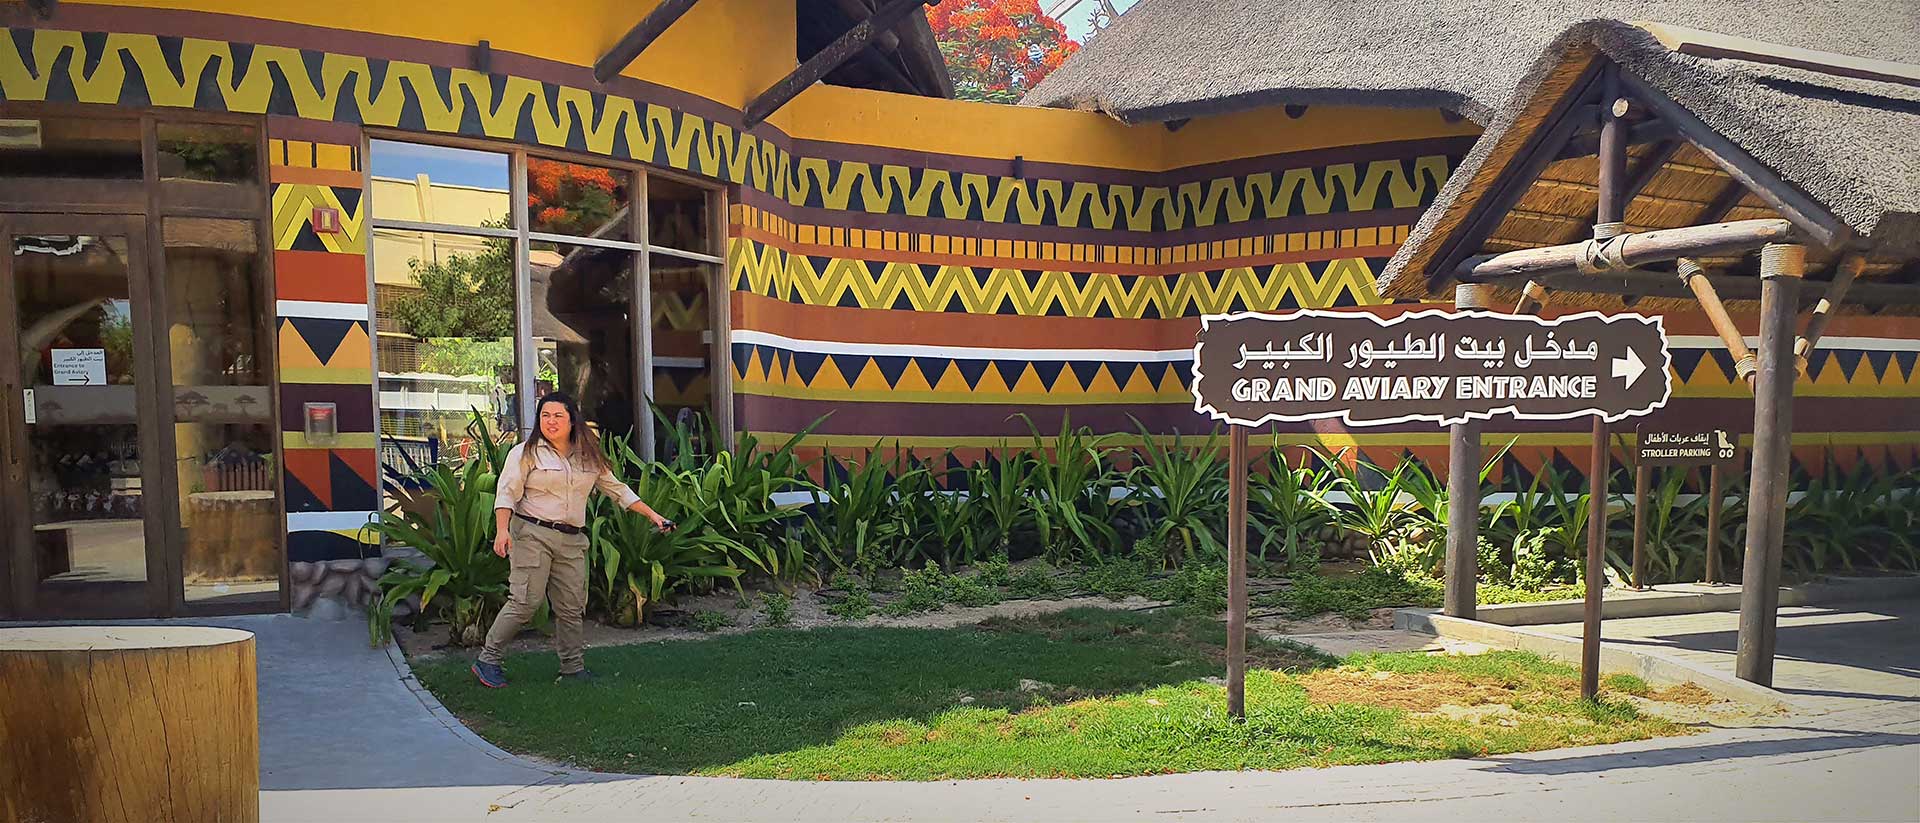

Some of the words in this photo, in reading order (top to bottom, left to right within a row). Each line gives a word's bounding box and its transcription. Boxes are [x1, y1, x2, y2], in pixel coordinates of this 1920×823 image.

[1232, 332, 1333, 369] الكبير
[1343, 332, 1446, 369] الطيور
[1454, 336, 1506, 368] بيت
[1513, 331, 1599, 368] مدخل
[1231, 377, 1337, 402] GRAND
[1342, 376, 1450, 401] AVIARY
[1455, 375, 1598, 399] ENTRANCE
[1644, 432, 1669, 445] الأطفال
[1669, 433, 1690, 445] عربات
[1690, 432, 1709, 445] إيقاف
[1641, 448, 1678, 458] STROLLER
[1679, 448, 1711, 457] PARKING
